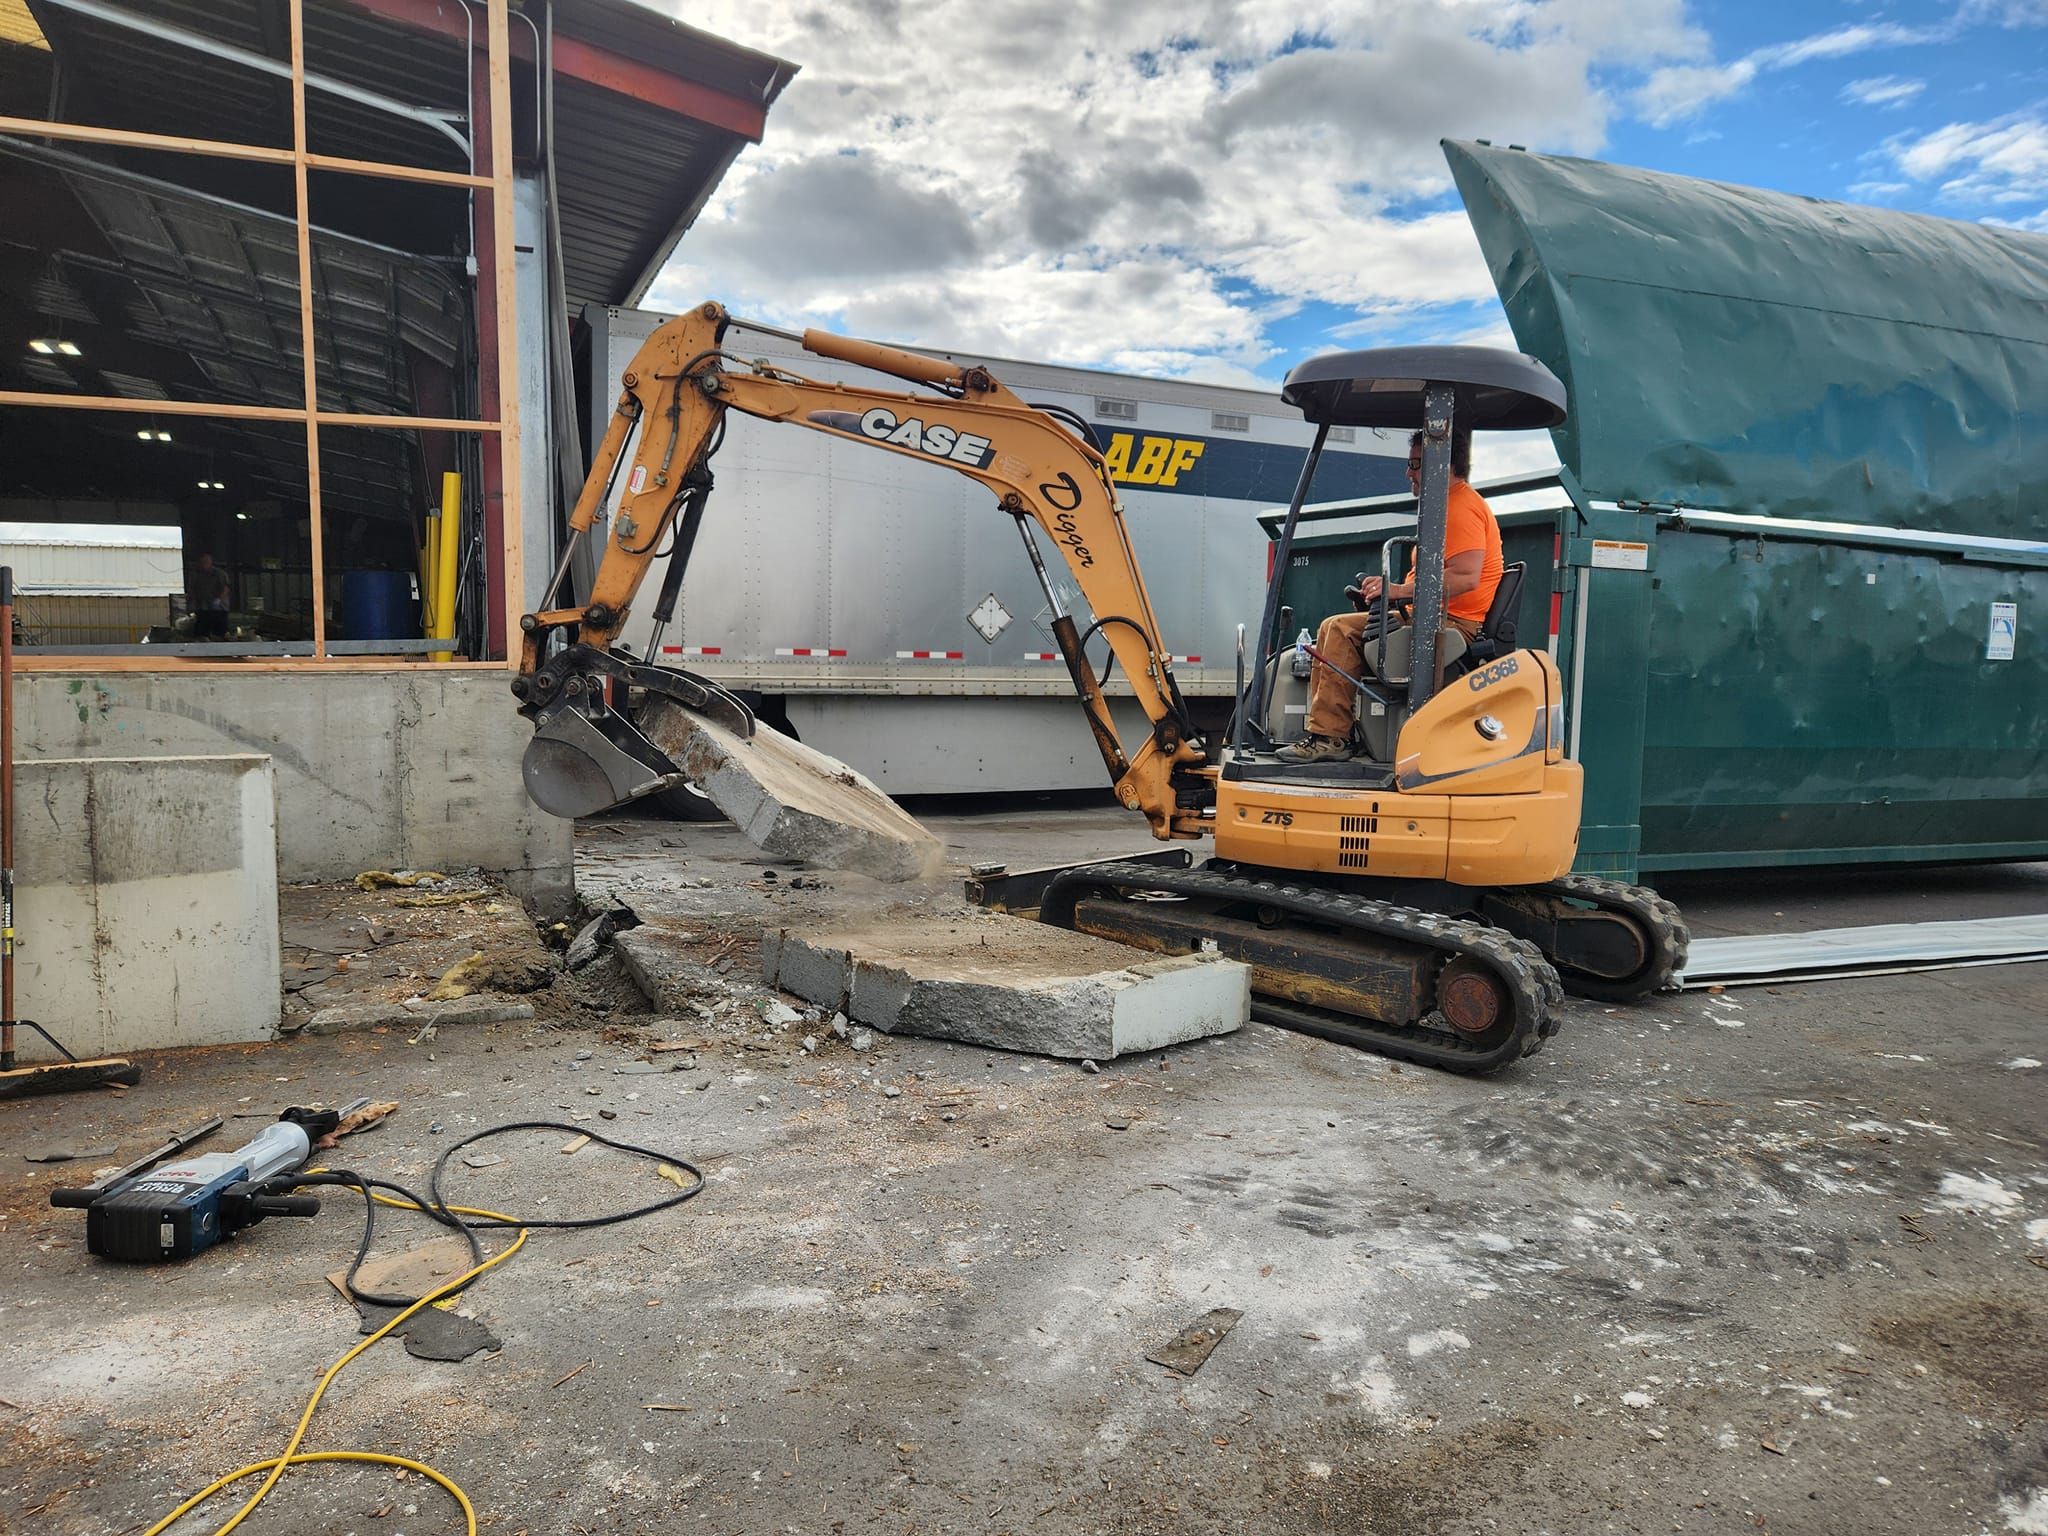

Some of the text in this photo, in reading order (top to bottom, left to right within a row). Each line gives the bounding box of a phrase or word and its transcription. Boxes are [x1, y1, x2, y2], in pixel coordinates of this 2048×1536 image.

[860, 407, 993, 466] CASE
[1095, 432, 1206, 487] ABF
[1039, 471, 1095, 569] Digger
[1293, 556, 1310, 567] 3075
[1469, 657, 1520, 692] CX36B
[1261, 810, 1294, 826] ZTS
[130, 1185, 186, 1194] BRUTE
